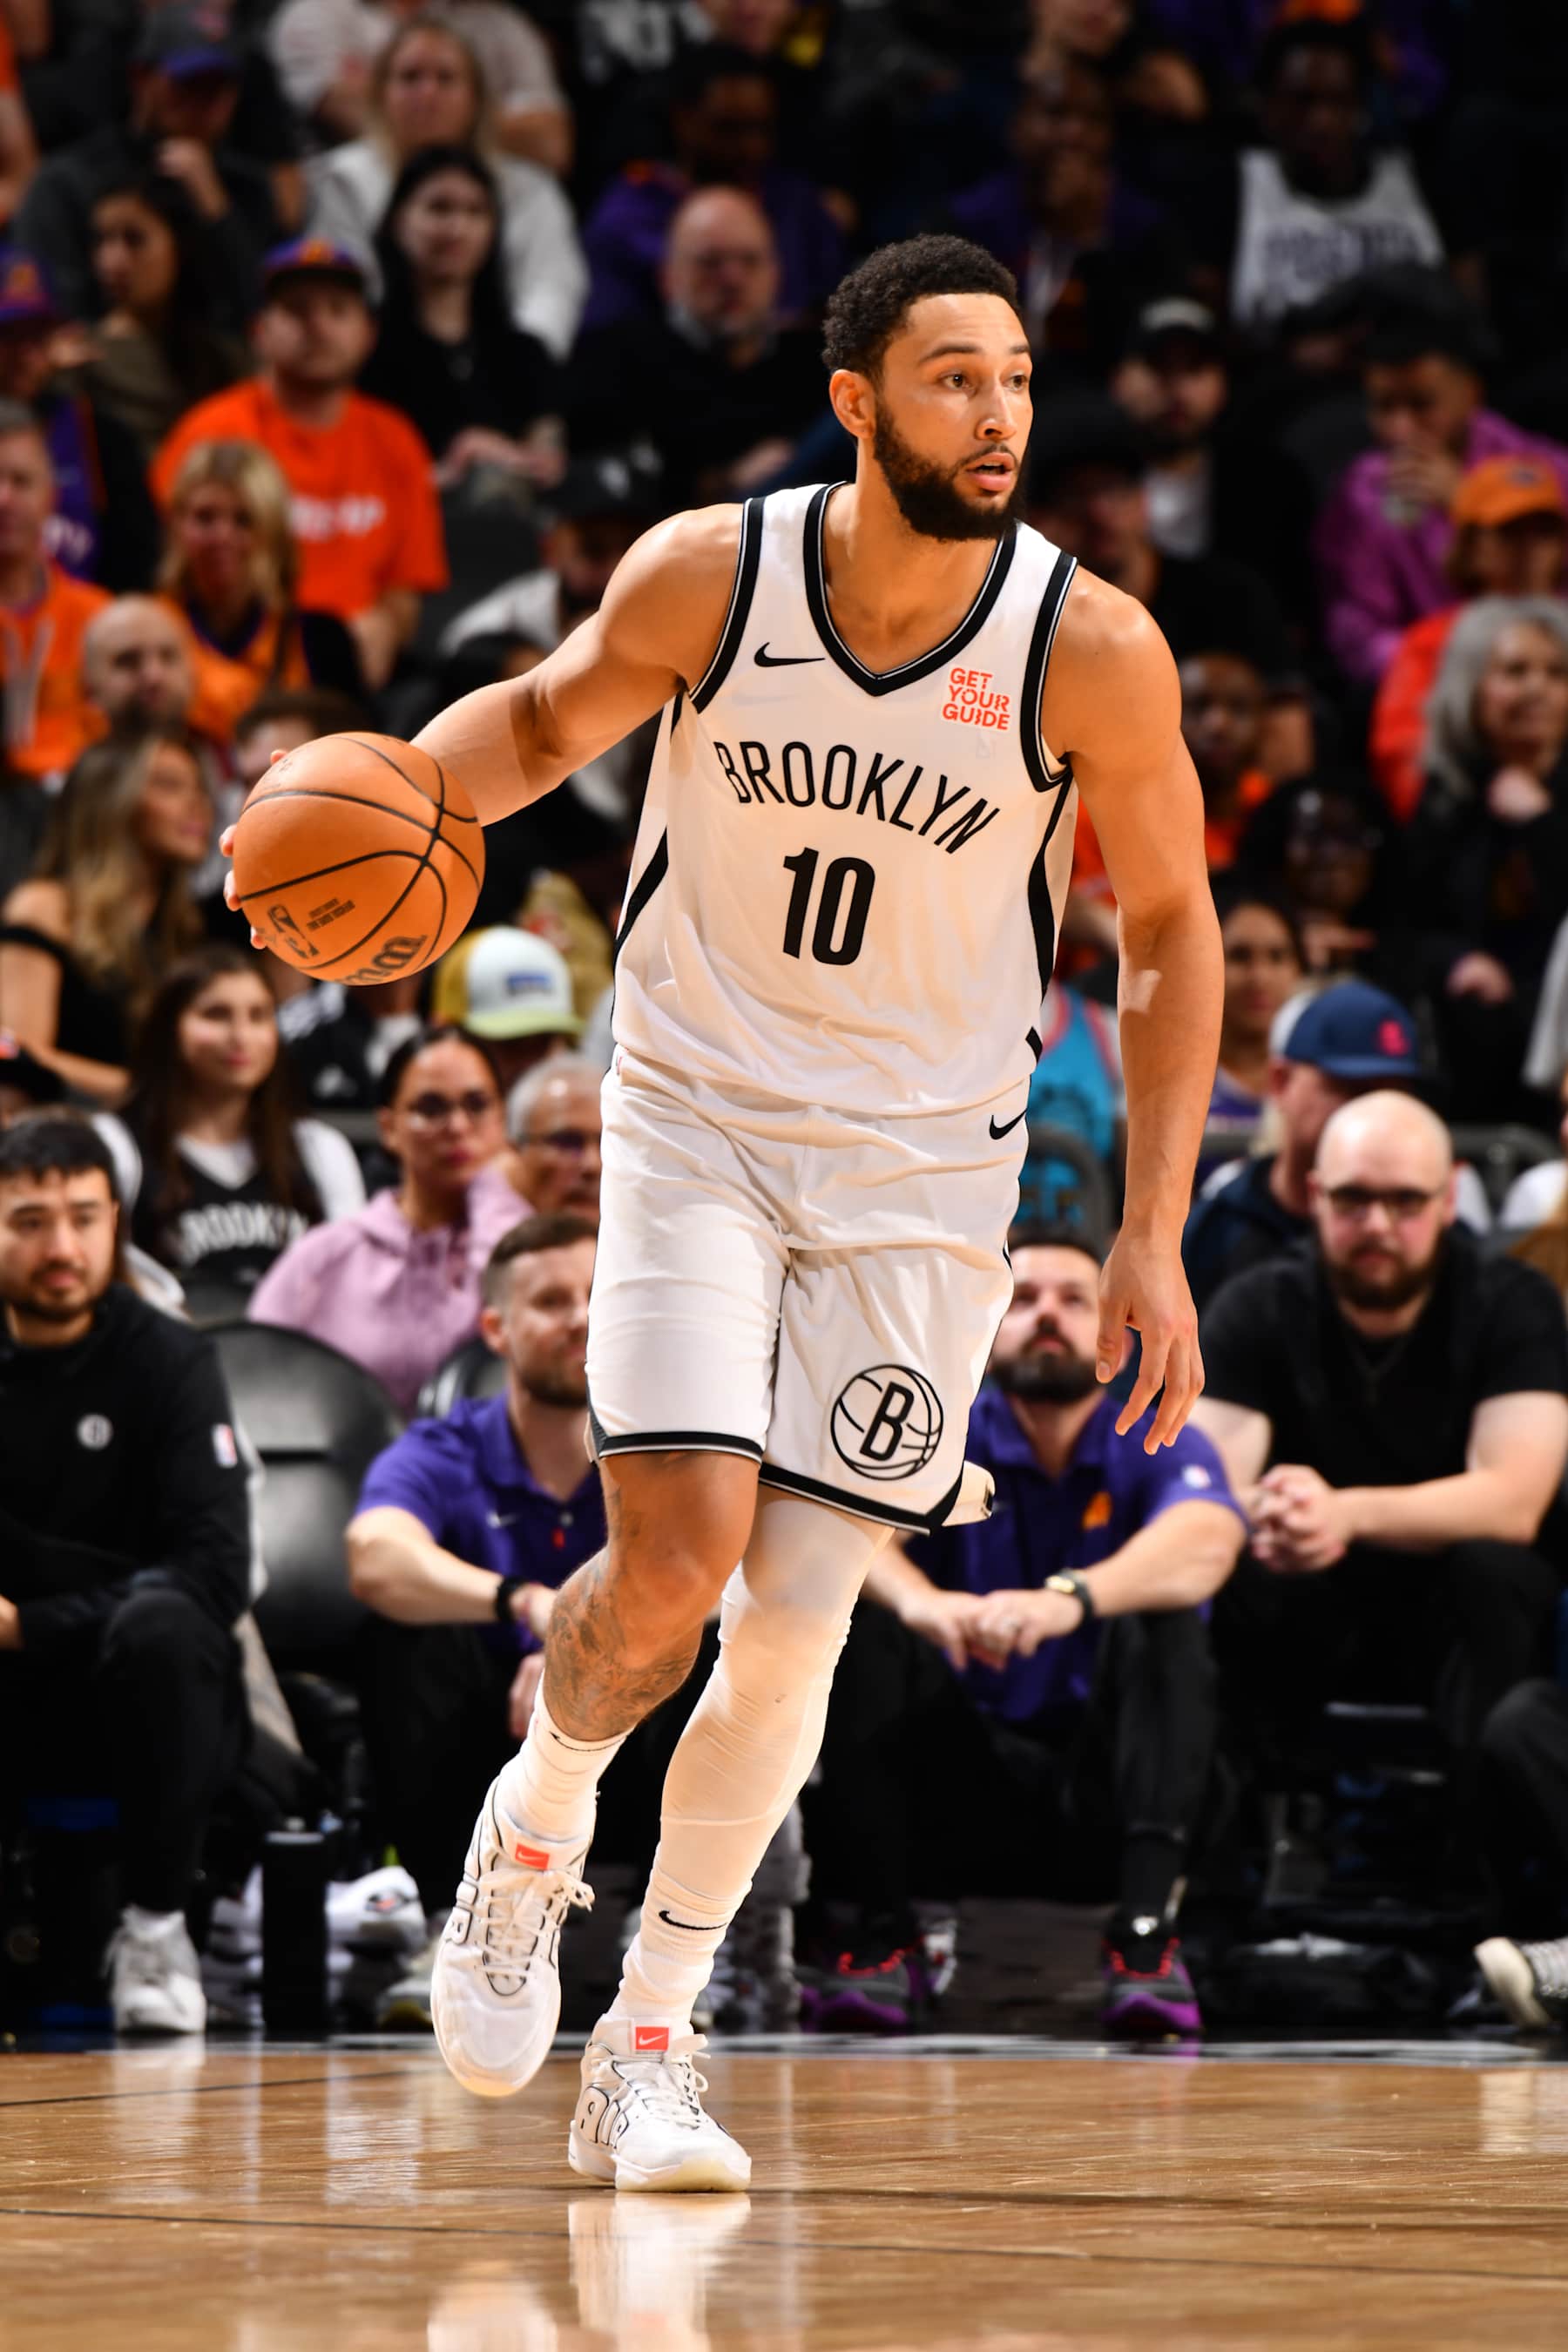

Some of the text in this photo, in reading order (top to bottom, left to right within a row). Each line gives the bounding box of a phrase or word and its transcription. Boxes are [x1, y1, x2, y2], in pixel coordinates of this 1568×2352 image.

[949, 685, 1010, 713] YOUR
[950, 667, 993, 690] GET
[943, 703, 1010, 731] GUIDE
[713, 741, 1000, 855] BROOKLYN
[783, 847, 875, 966] 10
[859, 1381, 915, 1462] B
